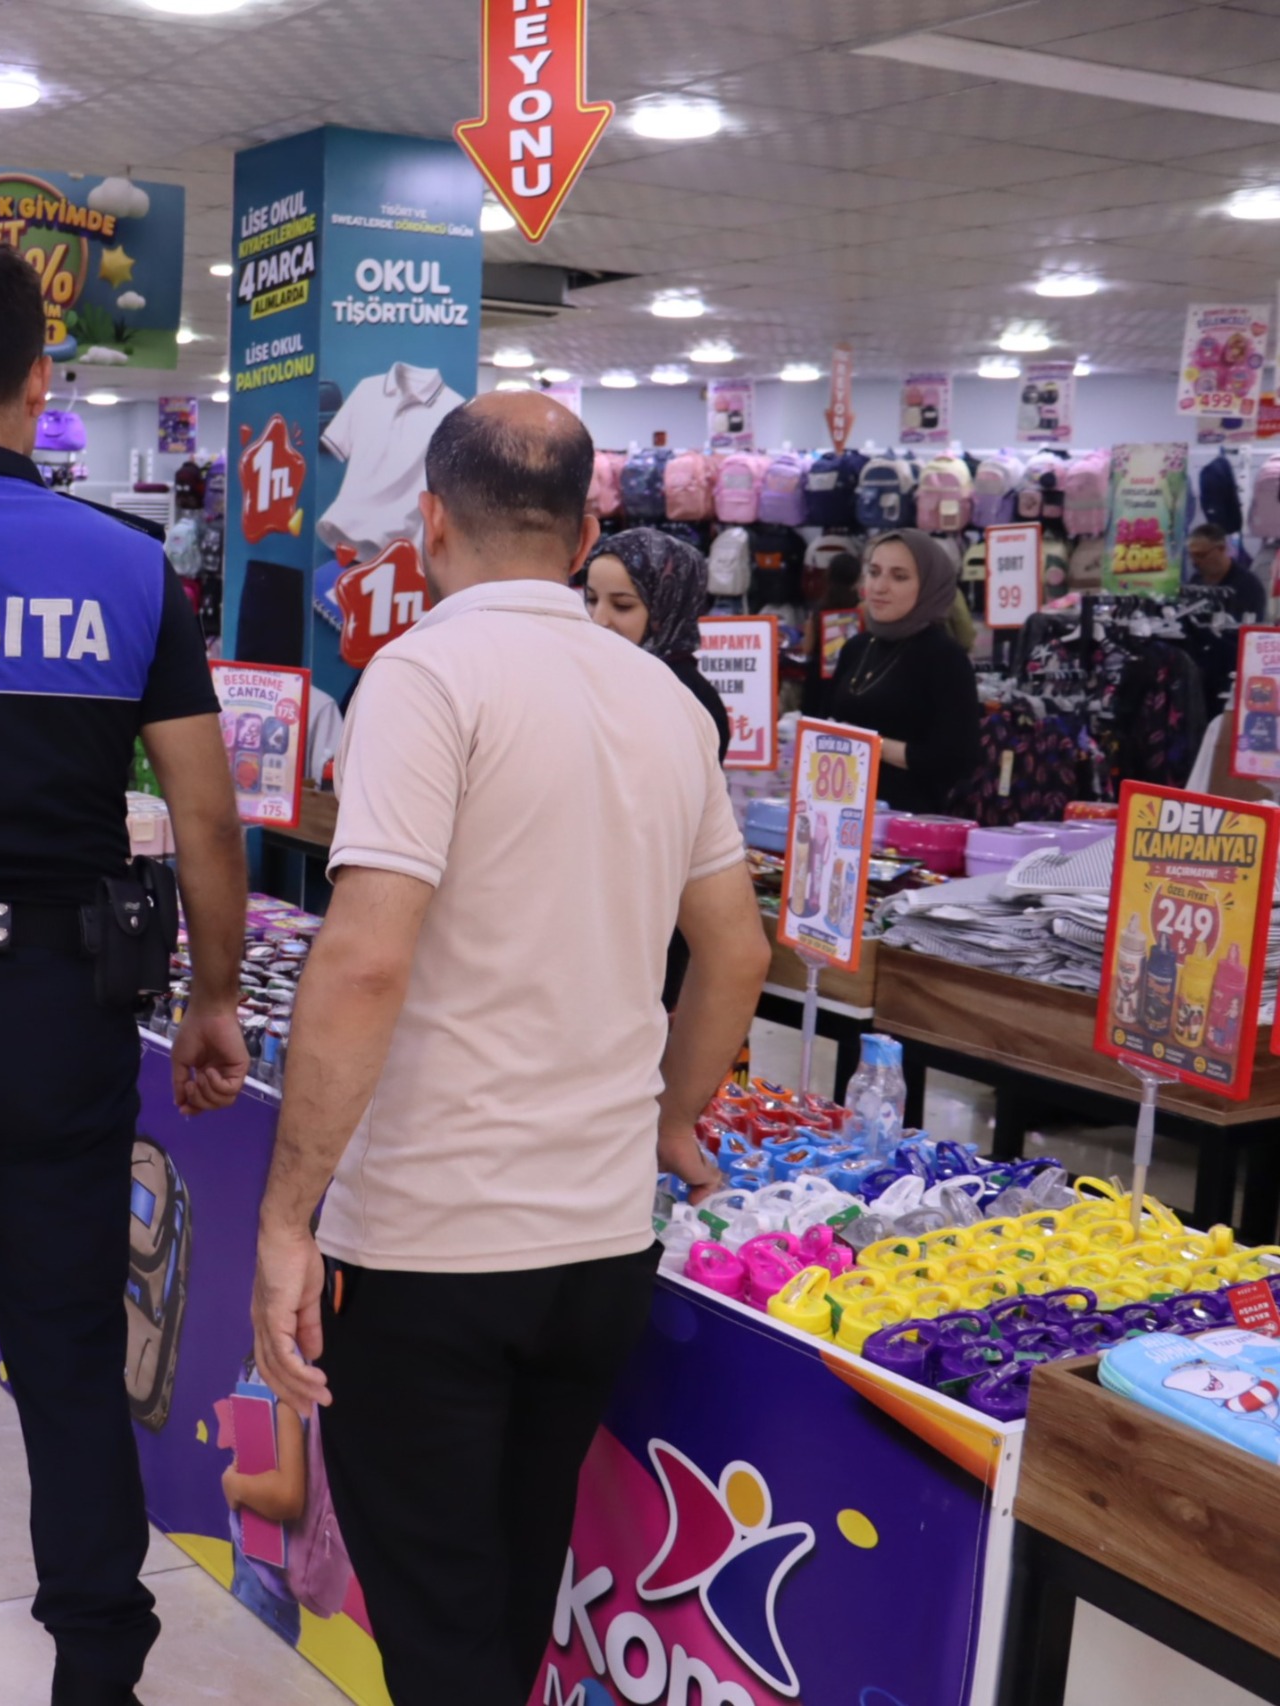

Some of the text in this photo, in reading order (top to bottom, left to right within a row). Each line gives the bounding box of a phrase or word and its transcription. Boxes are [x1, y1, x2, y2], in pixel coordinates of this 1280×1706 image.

[20, 194, 116, 237] GİYİMDE
[241, 190, 308, 239] LİSE OKUL
[238, 213, 317, 258] KIYAFETLERİNDE
[239, 241, 315, 302] 4 PARÇA
[355, 258, 451, 294] OKUL
[332, 295, 469, 327] TİŞÖRTÜNÜZ
[246, 334, 304, 366] LİSE OKUL
[236, 354, 315, 392] PANTOLONU
[700, 634, 762, 650] AMPANYA
[701, 655, 757, 672] ÜKENMEZ
[223, 674, 284, 691] BESLENME
[228, 686, 279, 702] ÇANTASI
[716, 679, 744, 694] ALEM
[1158, 800, 1225, 835] DEV
[1133, 831, 1255, 865] KAMPANYA!
[1166, 881, 1209, 902] ÖZEL FİYAT
[1156, 898, 1214, 942] 249
